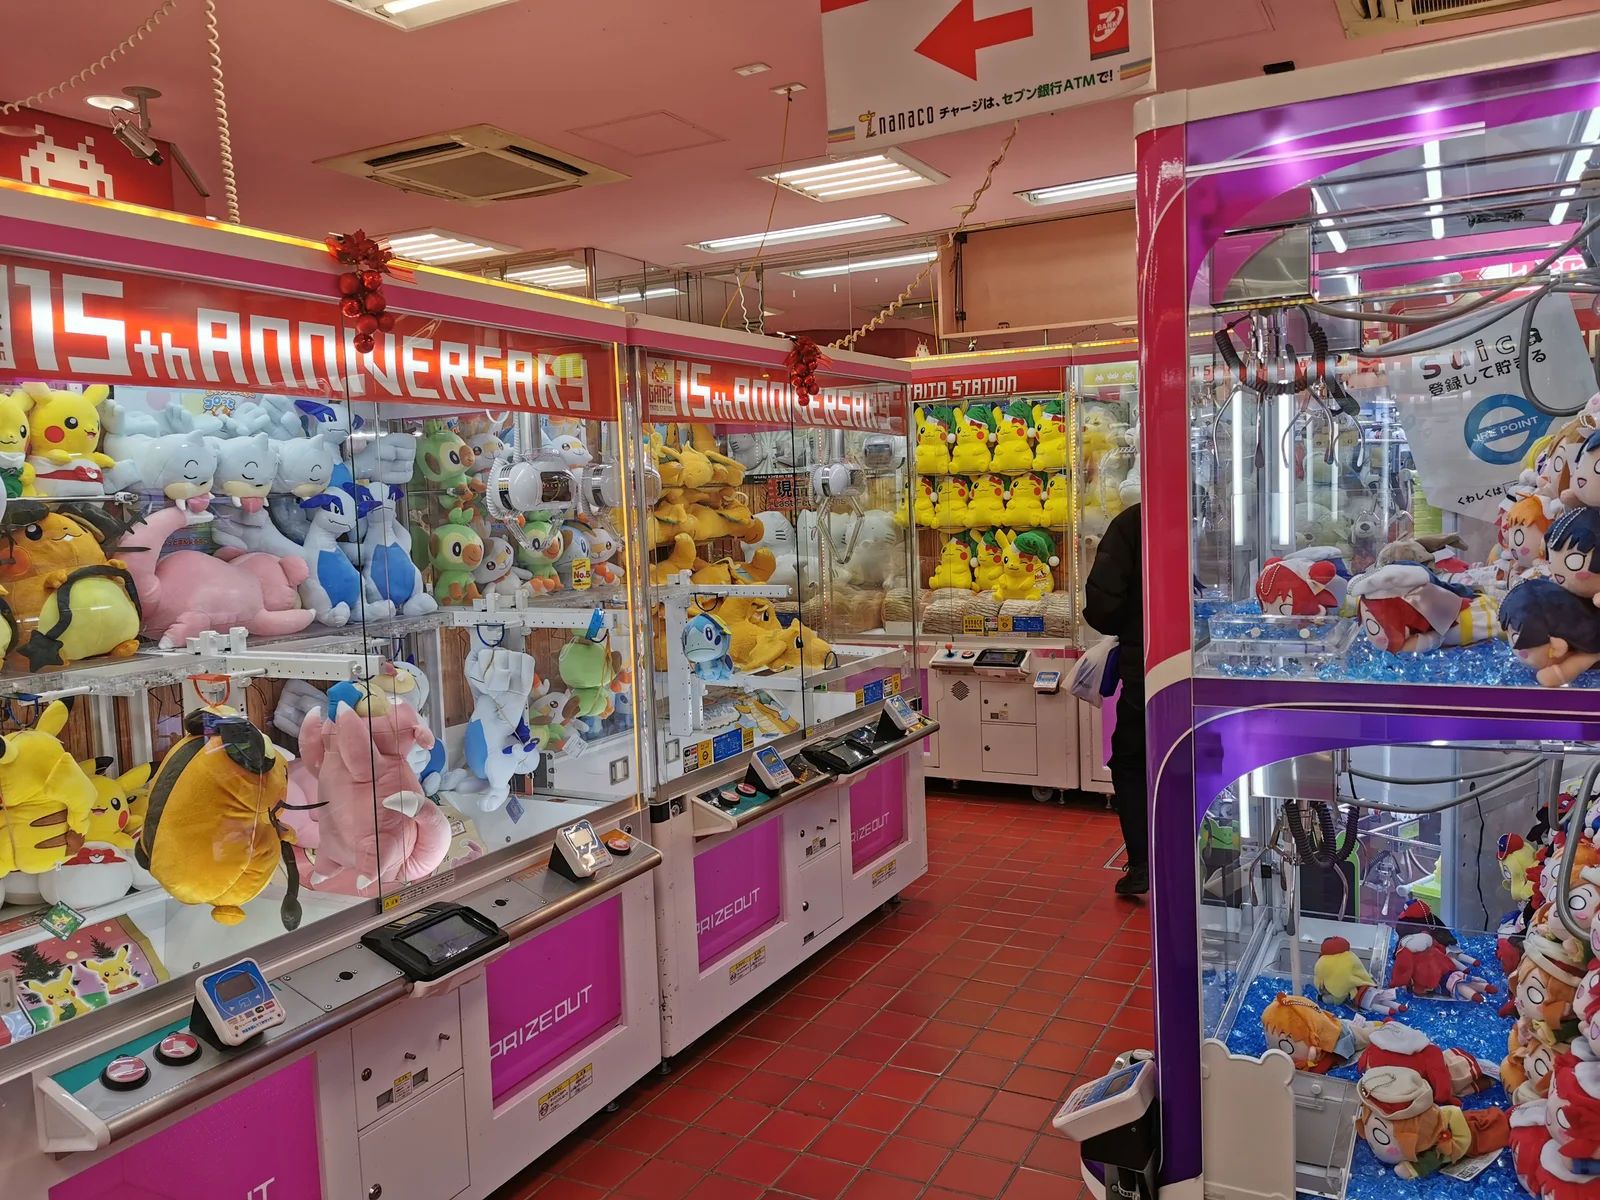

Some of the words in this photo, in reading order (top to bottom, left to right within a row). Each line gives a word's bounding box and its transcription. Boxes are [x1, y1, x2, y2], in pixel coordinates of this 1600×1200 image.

[879, 106, 935, 135] nanaco
[911, 382, 947, 400] AITO
[951, 375, 1017, 397] STATION
[1499, 415, 1539, 434] POINT
[1457, 486, 1503, 506] くわしくは
